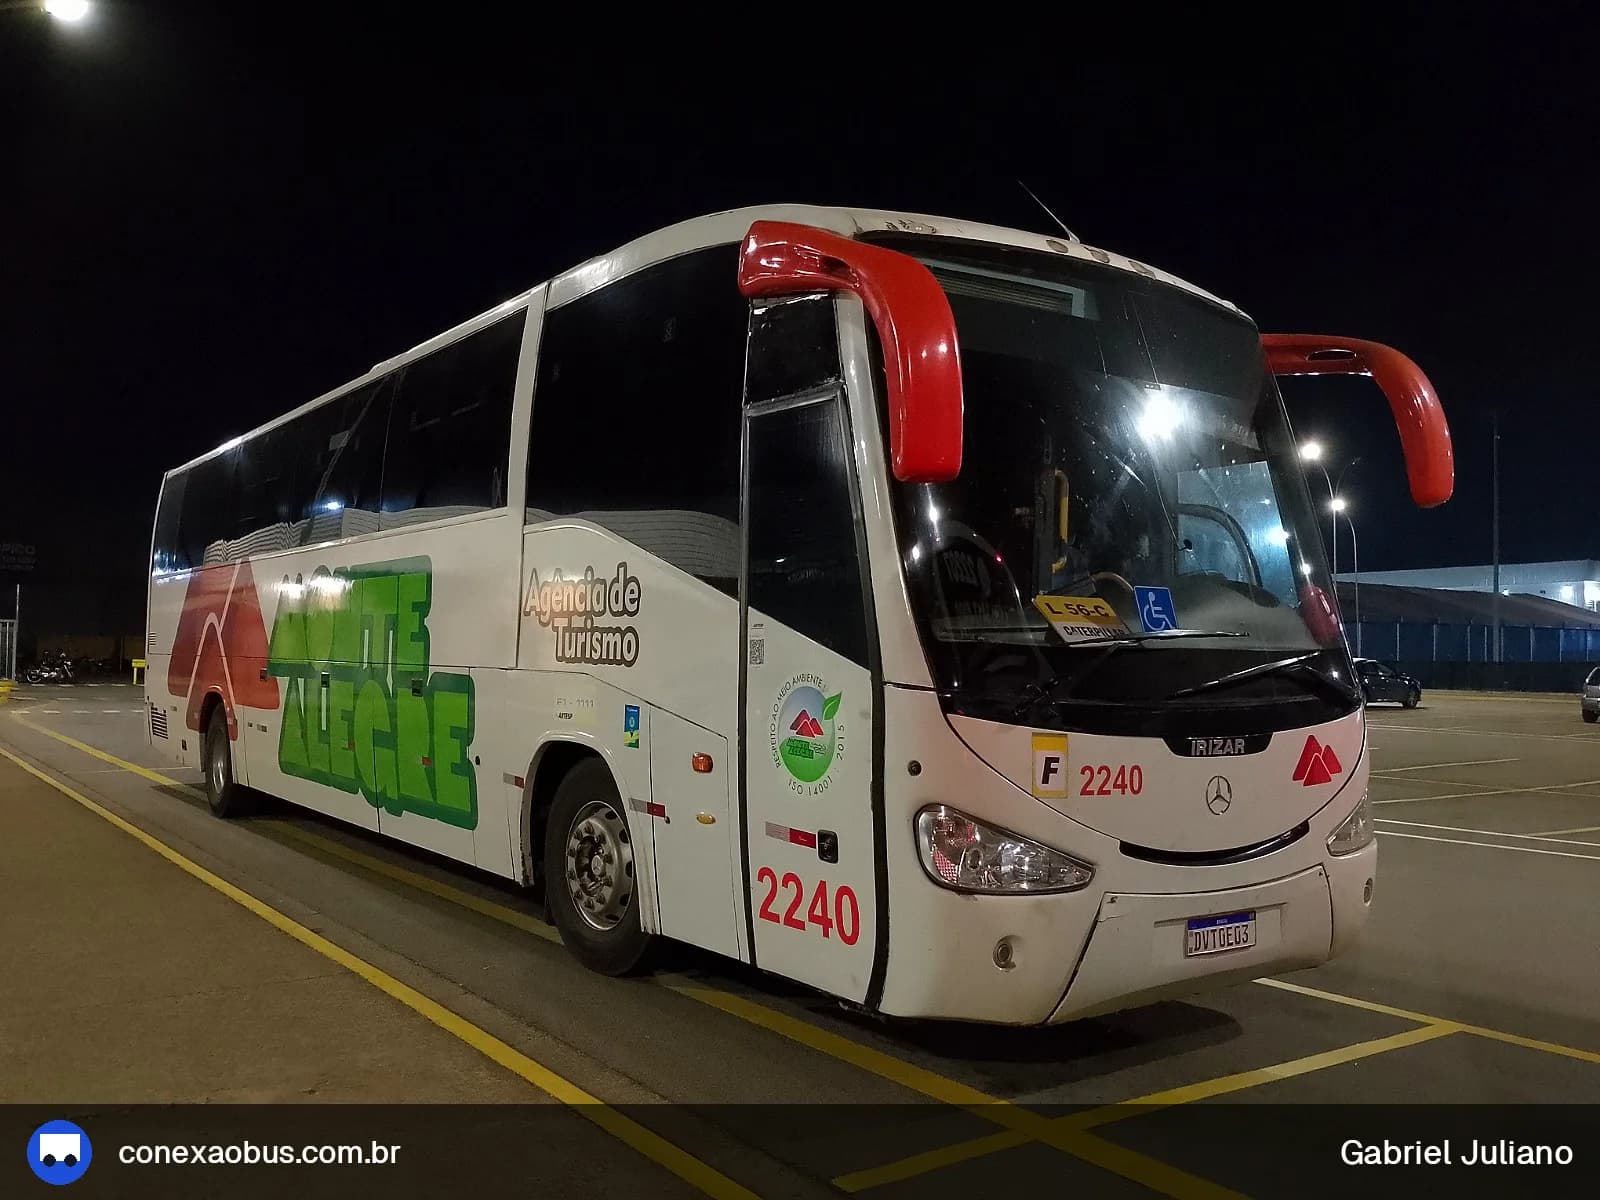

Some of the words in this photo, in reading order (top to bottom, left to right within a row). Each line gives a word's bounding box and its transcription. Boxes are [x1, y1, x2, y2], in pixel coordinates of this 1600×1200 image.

[525, 569, 606, 625] Agência
[609, 562, 641, 617] de
[1045, 602, 1062, 615] L
[1064, 603, 1110, 617] 56-C
[552, 615, 639, 667] Turismo
[280, 673, 476, 828] ALEGRE
[1191, 739, 1245, 756] IRIZAR
[1041, 757, 1060, 784] F
[1079, 765, 1143, 796] 2240
[757, 866, 860, 945] 2240
